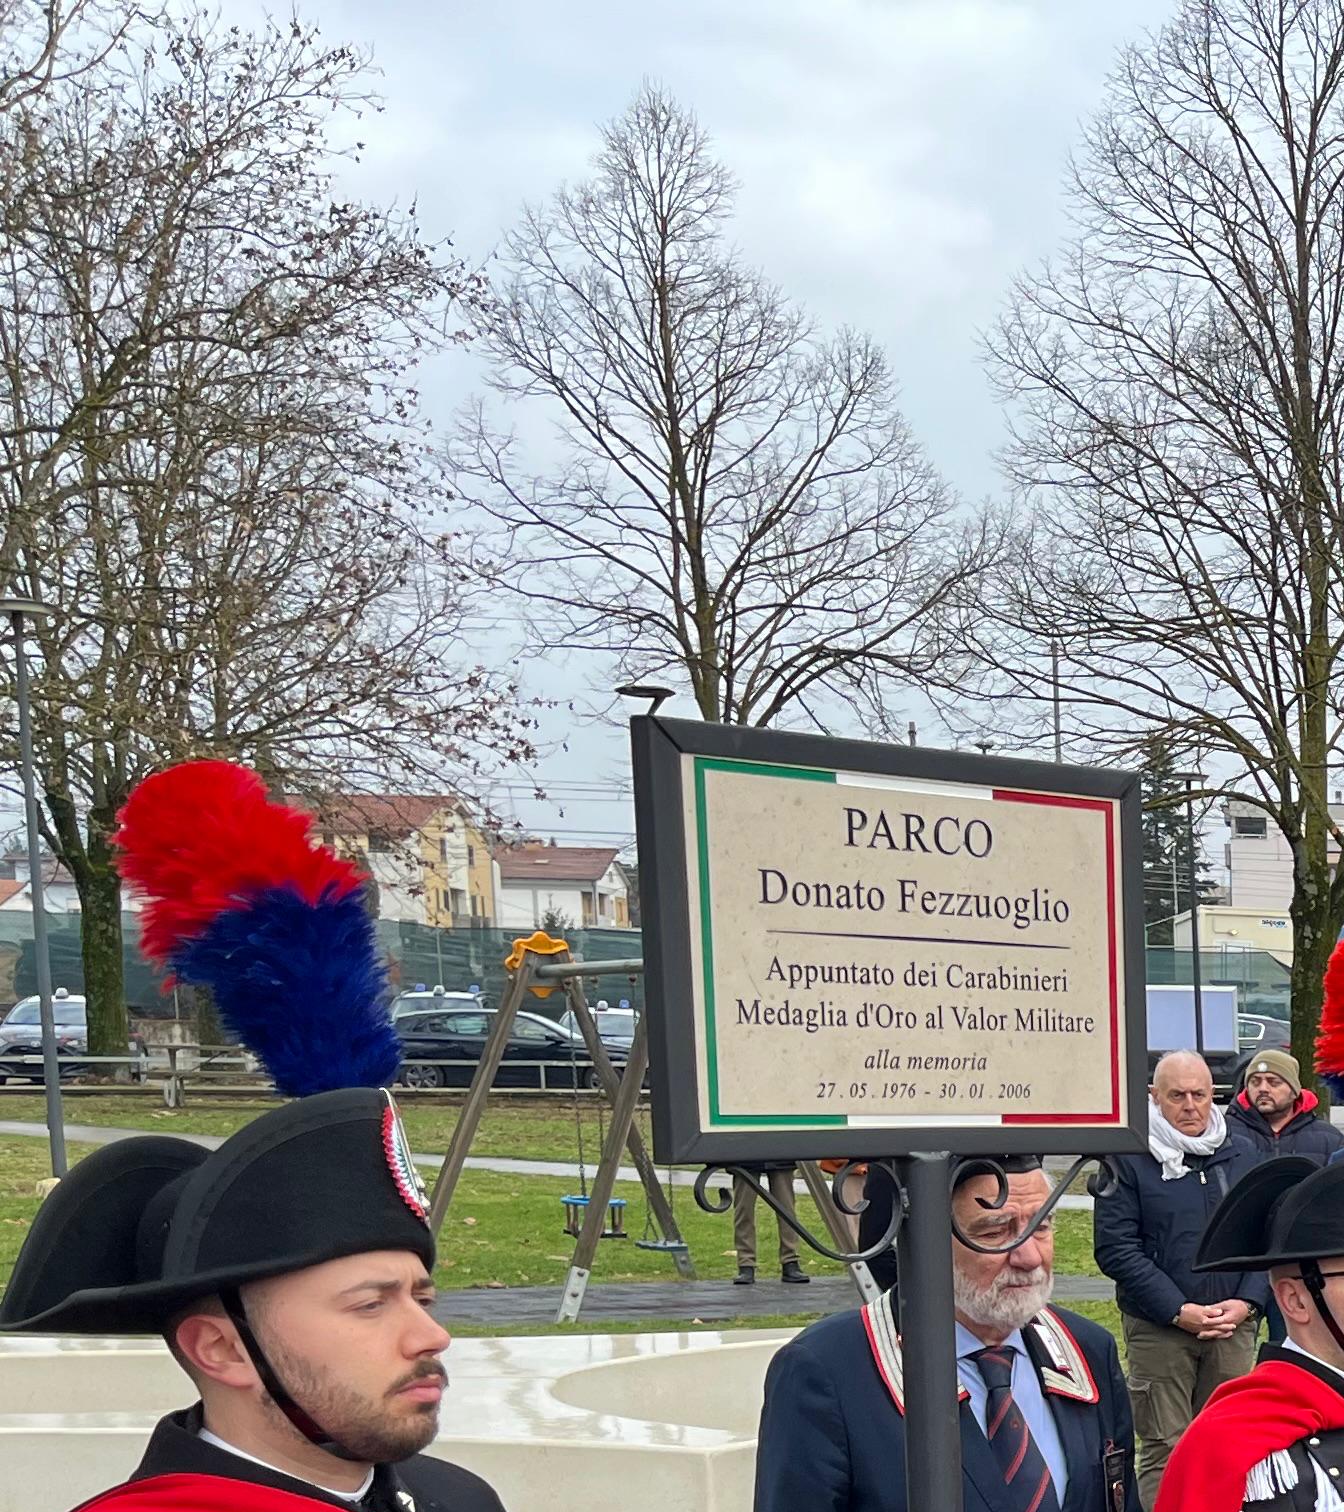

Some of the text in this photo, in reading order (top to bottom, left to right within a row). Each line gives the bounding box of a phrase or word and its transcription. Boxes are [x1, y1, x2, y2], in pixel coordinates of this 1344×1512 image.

[843, 807, 993, 858] PARCO
[757, 868, 1070, 929] Donato Fezzuoglio
[765, 956, 1069, 992] Appuntato dei Carabinieri
[735, 999, 1095, 1034] Medaglia d'Oro al Valor Militare
[864, 1049, 988, 1071] alla memoria
